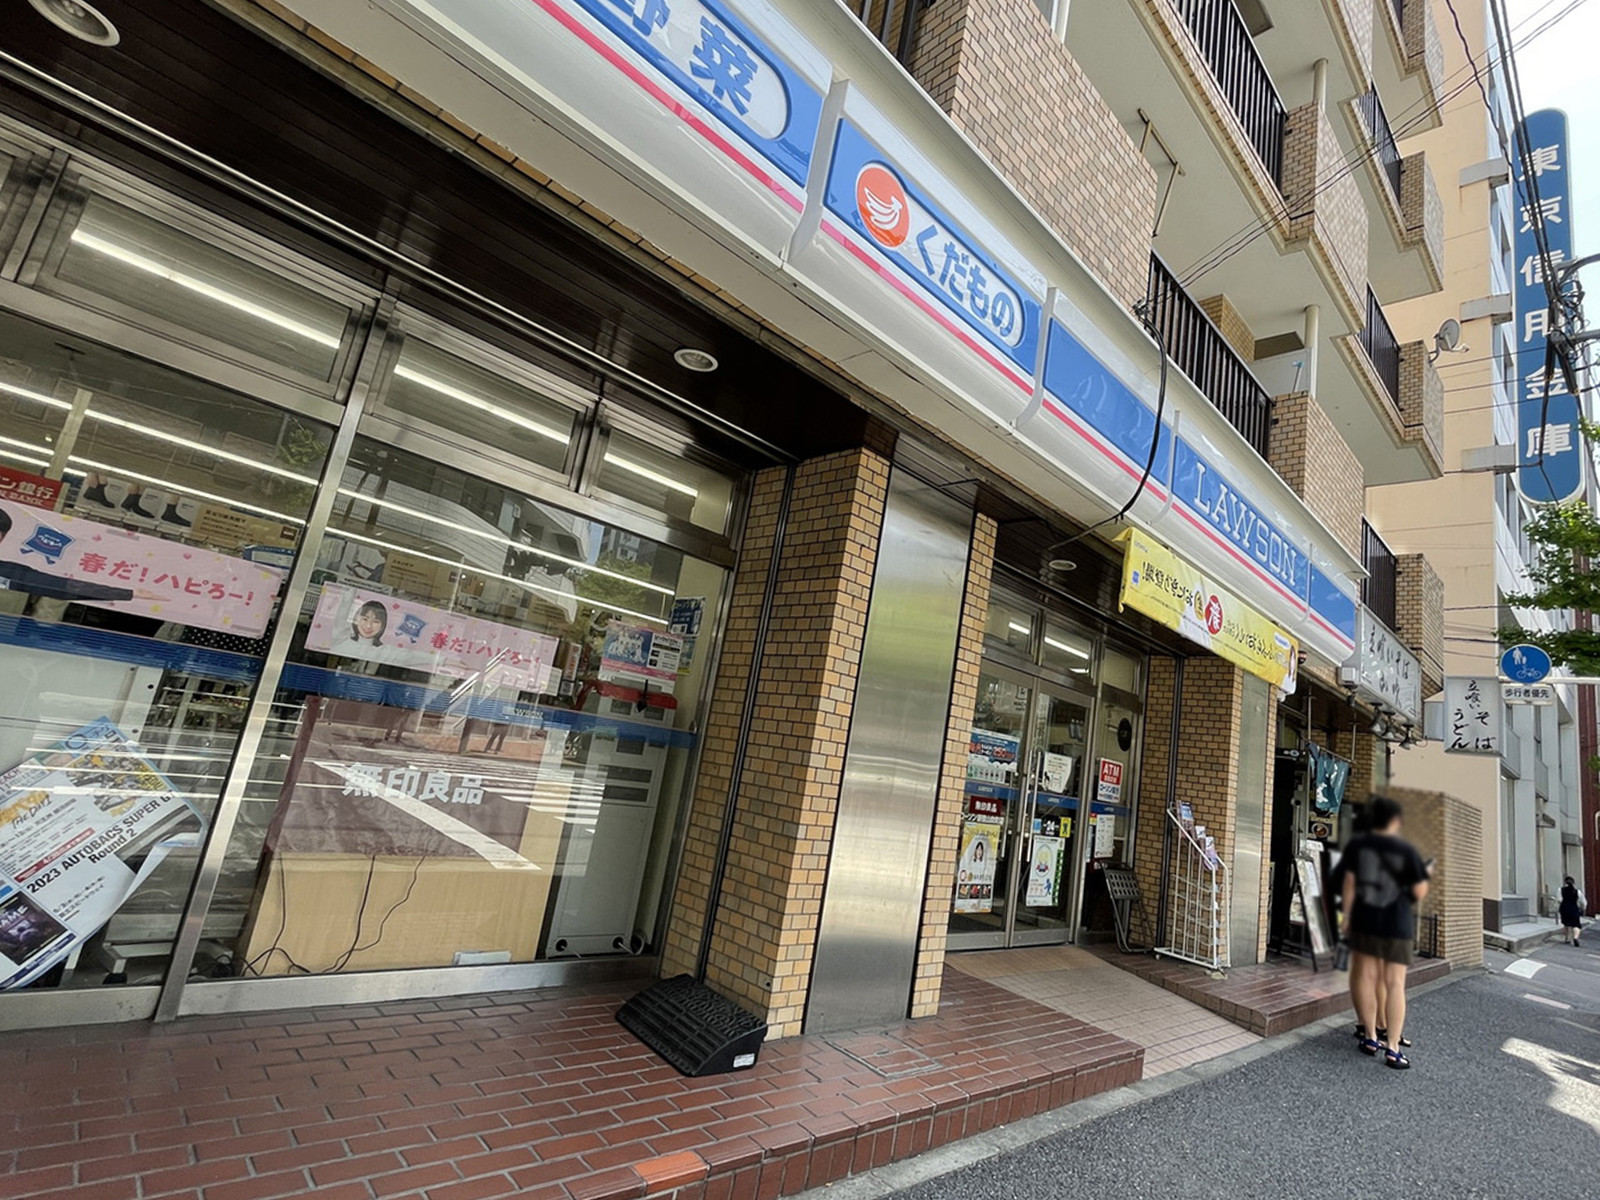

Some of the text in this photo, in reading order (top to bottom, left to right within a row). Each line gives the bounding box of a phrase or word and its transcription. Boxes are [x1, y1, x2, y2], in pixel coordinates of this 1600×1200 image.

[916, 224, 1016, 335] くだもの
[1194, 460, 1298, 586] LAWSON
[1505, 688, 1550, 698] 歩行者優先
[1451, 708, 1470, 749] うどん
[1475, 711, 1496, 750] そば
[343, 763, 485, 805] 無印良品
[1102, 763, 1121, 777] ATM
[26, 869, 61, 893] 2023
[62, 826, 122, 871] AUTOBACS
[122, 799, 160, 828] SUPER
[89, 833, 127, 865] Round
[125, 827, 138, 841] 2
